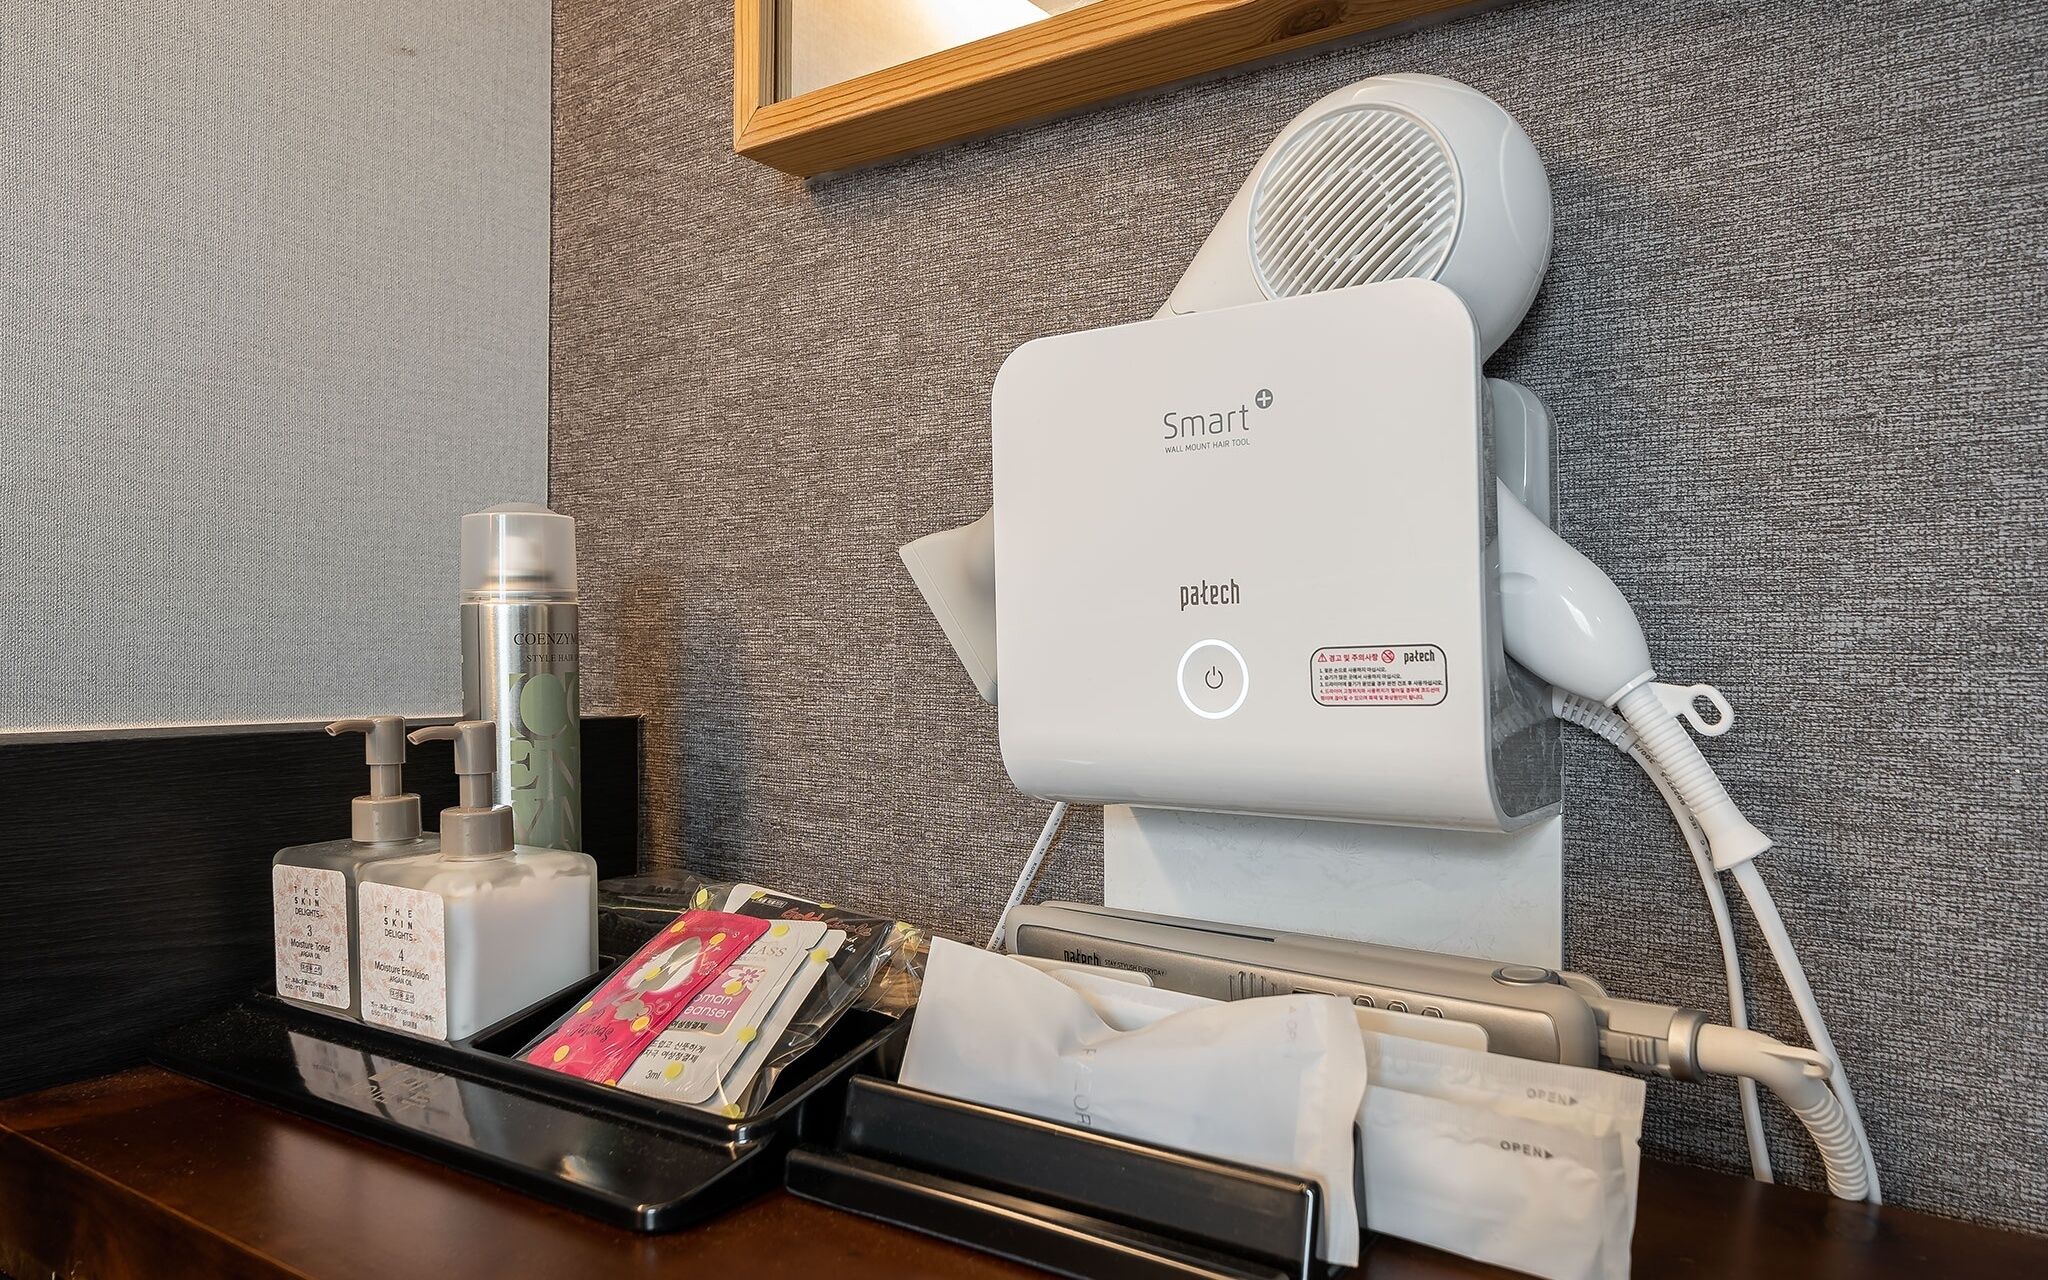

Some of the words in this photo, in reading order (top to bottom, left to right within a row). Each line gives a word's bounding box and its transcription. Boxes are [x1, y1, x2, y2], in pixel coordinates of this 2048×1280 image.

[1163, 404, 1250, 440] Smart
[1164, 446, 1183, 454] WALL
[1185, 442, 1210, 452] MOUNT
[1212, 440, 1230, 449] HAIR
[1232, 438, 1250, 447] TOOL
[1180, 579, 1240, 611] patech
[526, 654, 556, 663] STYLE
[1329, 654, 1341, 662] 경고
[1344, 654, 1350, 662] 및
[1352, 653, 1378, 662] 주의사항
[1403, 650, 1435, 665] patech
[294, 896, 320, 907] SKIN
[294, 907, 320, 918] DELIGHTS
[383, 905, 413, 919] THE
[383, 917, 413, 930] SKIN
[306, 924, 313, 937] 3
[384, 928, 413, 942] DELIGHTS
[290, 938, 314, 950] Moisture
[398, 949, 404, 961] 4
[745, 945, 788, 957] LASS
[374, 960, 400, 975] Moisture
[694, 992, 733, 1006] oman
[683, 1005, 732, 1019] eanser
[644, 1049, 659, 1058] 자극
[645, 1069, 662, 1080] 3ml
[1526, 1088, 1569, 1106] OPEN
[1500, 1140, 1544, 1158] OPEN
